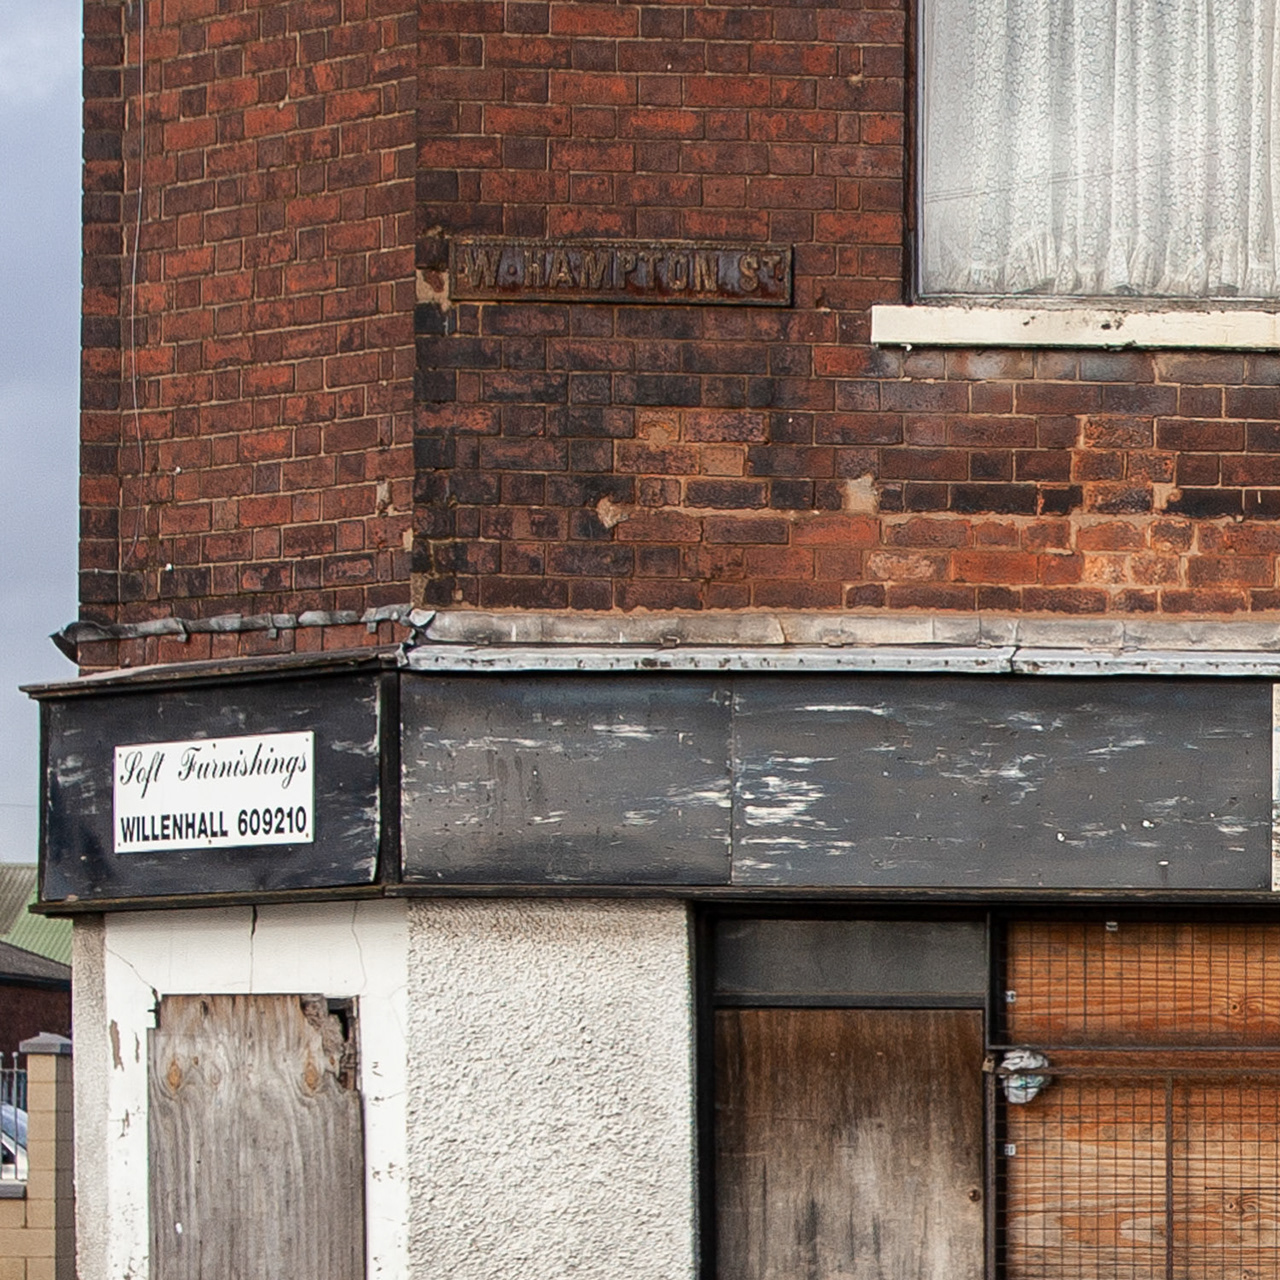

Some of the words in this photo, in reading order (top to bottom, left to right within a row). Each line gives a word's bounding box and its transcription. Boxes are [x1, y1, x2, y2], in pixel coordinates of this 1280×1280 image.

[120, 751, 165, 799] Soft
[178, 742, 307, 789] Furnishings
[120, 811, 228, 843] WILLENHALL
[238, 806, 307, 836] 609210
